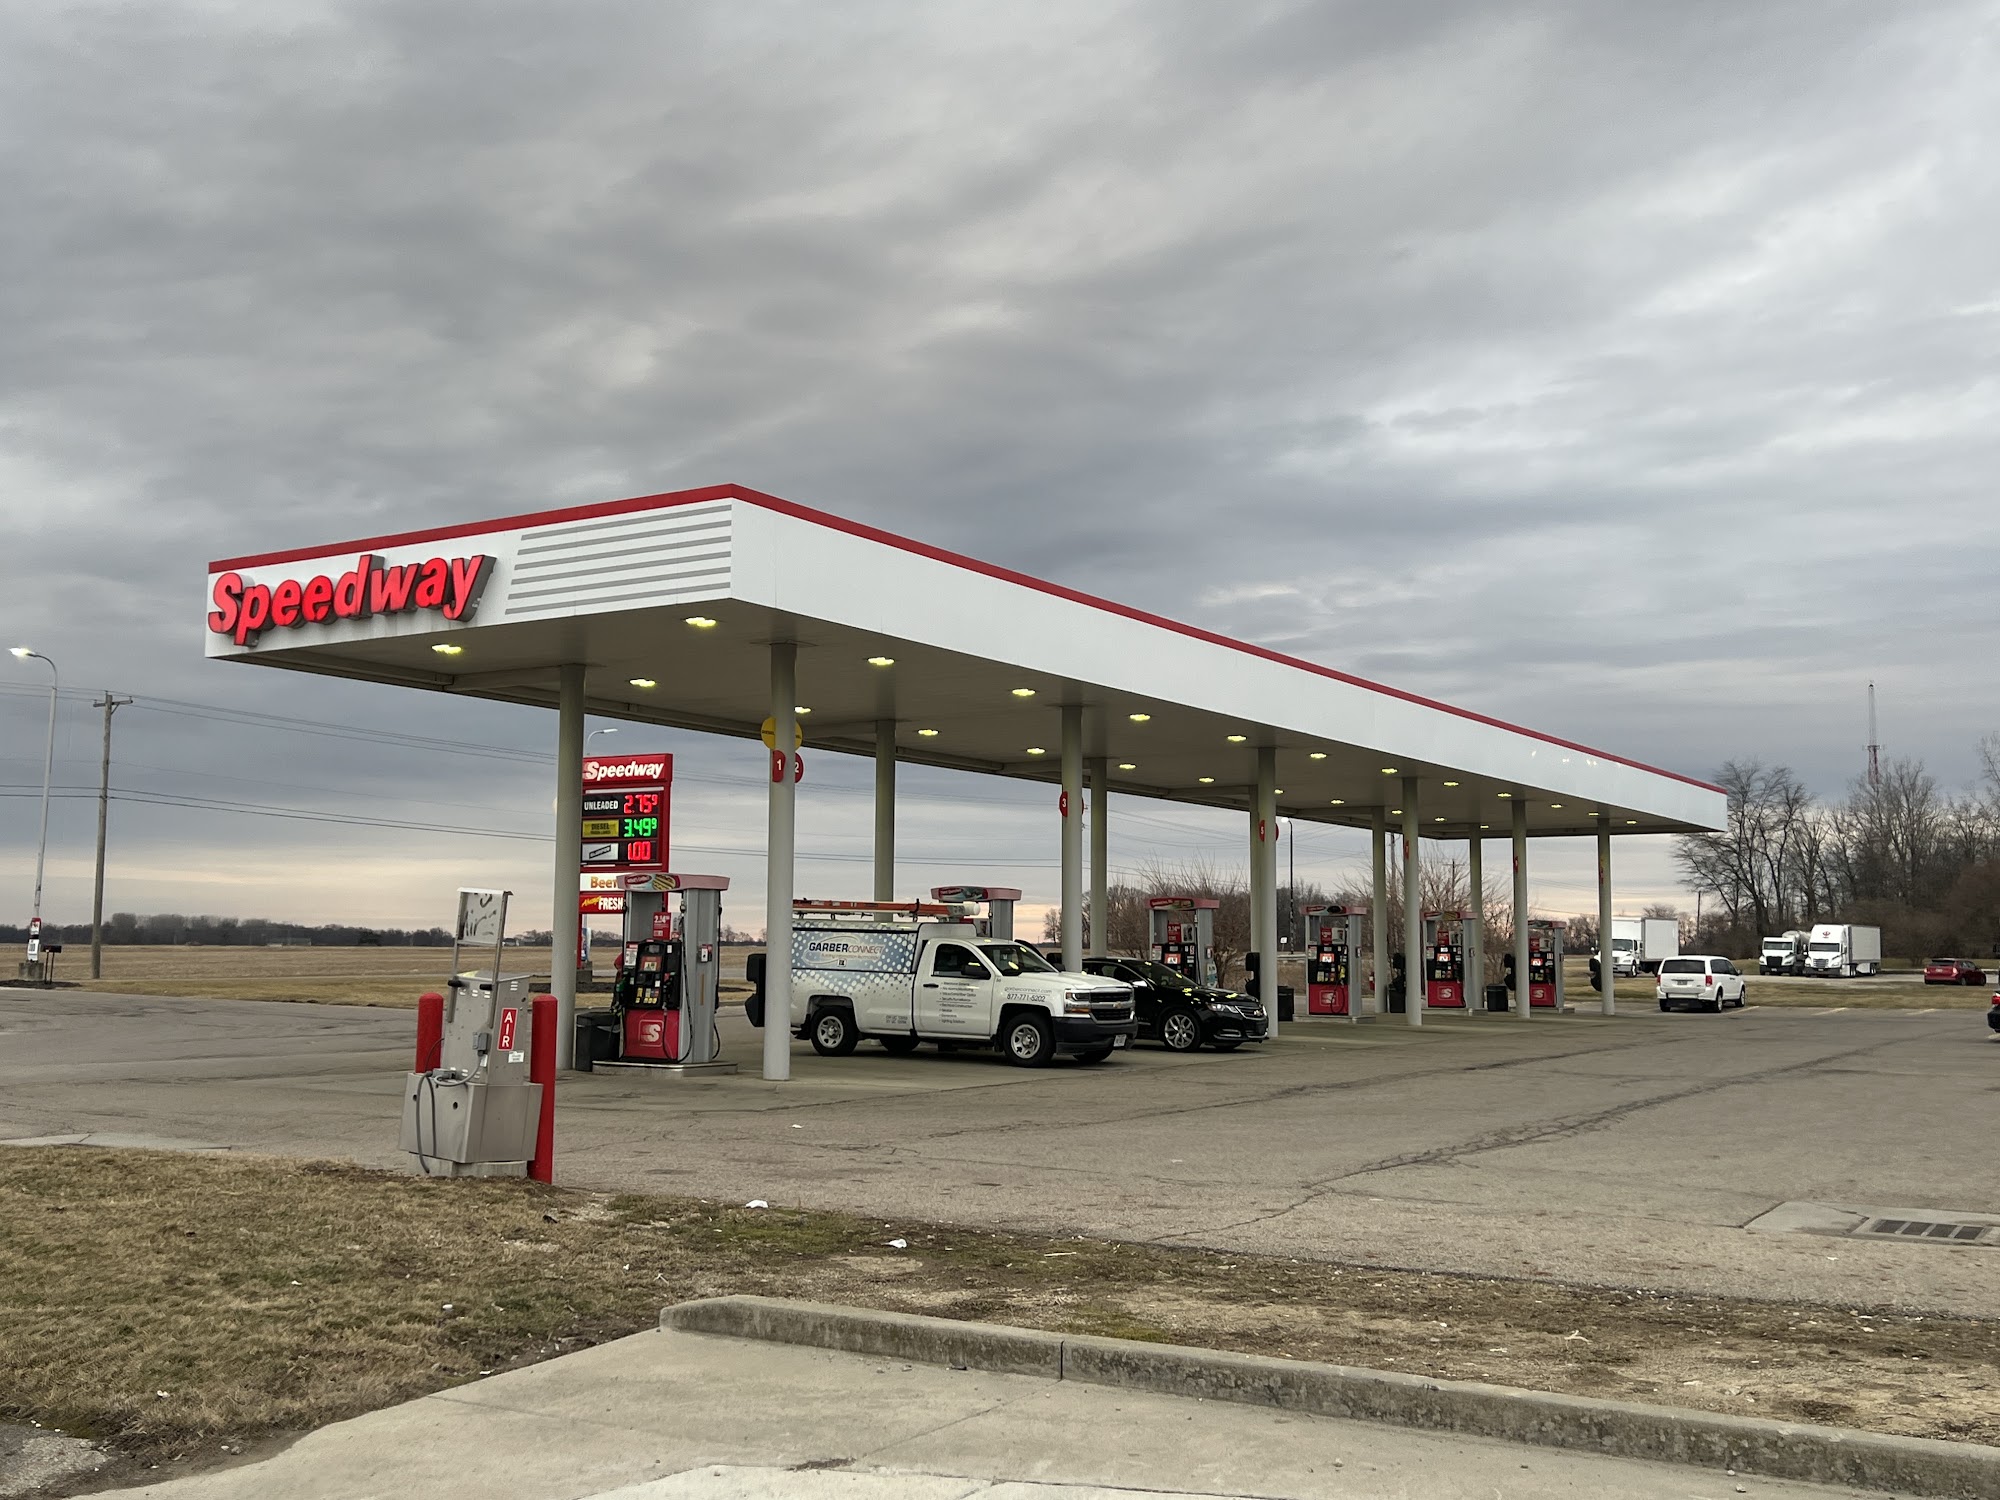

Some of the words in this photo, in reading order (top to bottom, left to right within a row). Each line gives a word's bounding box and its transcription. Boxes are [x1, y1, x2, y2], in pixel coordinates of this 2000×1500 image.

[208, 554, 490, 646] Speedway
[777, 759, 782, 770] 1
[795, 762, 800, 773] 2
[585, 761, 664, 781] Speedway
[584, 800, 619, 811] UNLEADED
[591, 822, 609, 831] DIESEL
[598, 897, 623, 910] FRESH
[502, 1011, 513, 1048] AIR
